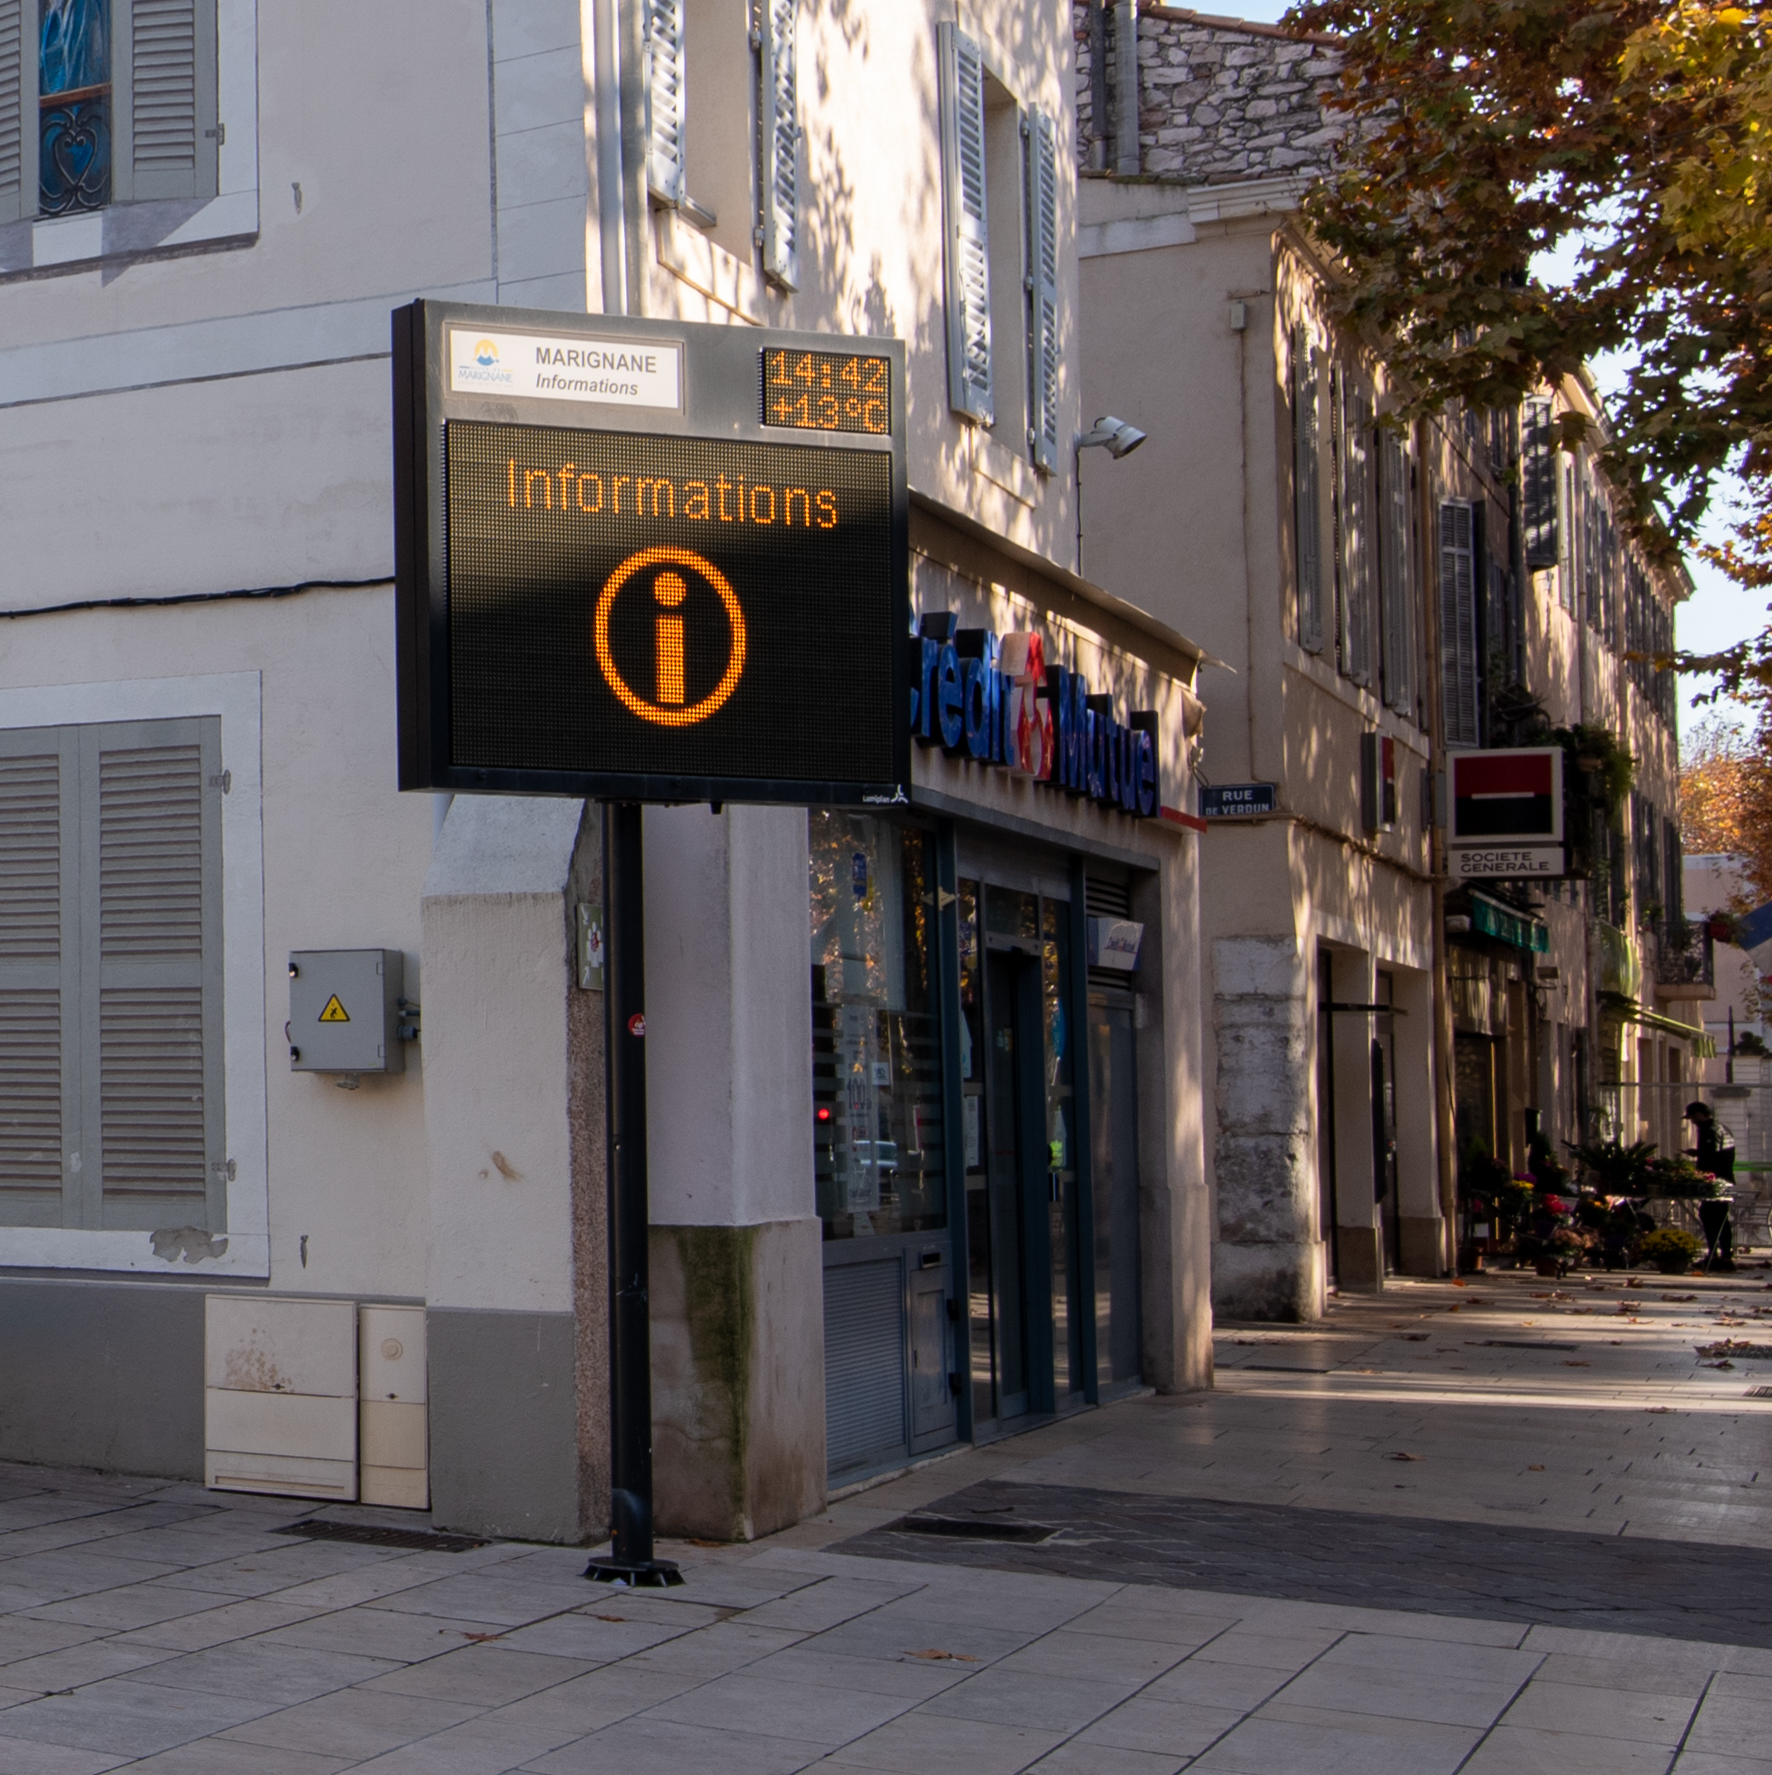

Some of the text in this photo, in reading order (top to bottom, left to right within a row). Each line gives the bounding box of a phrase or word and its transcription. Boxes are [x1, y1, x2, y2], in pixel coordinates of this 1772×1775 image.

[535, 347, 657, 373] MARIGNANE
[458, 369, 513, 383] MARIGNANE
[772, 351, 884, 392] 14:42
[536, 373, 638, 396] Informations
[772, 393, 885, 433] +13°C
[509, 458, 837, 528] Informations
[1222, 790, 1253, 801] RUE
[1205, 803, 1269, 816] DE VERDUN
[1460, 851, 1532, 863] SOCIETE
[1460, 861, 1549, 873] GENERALE
